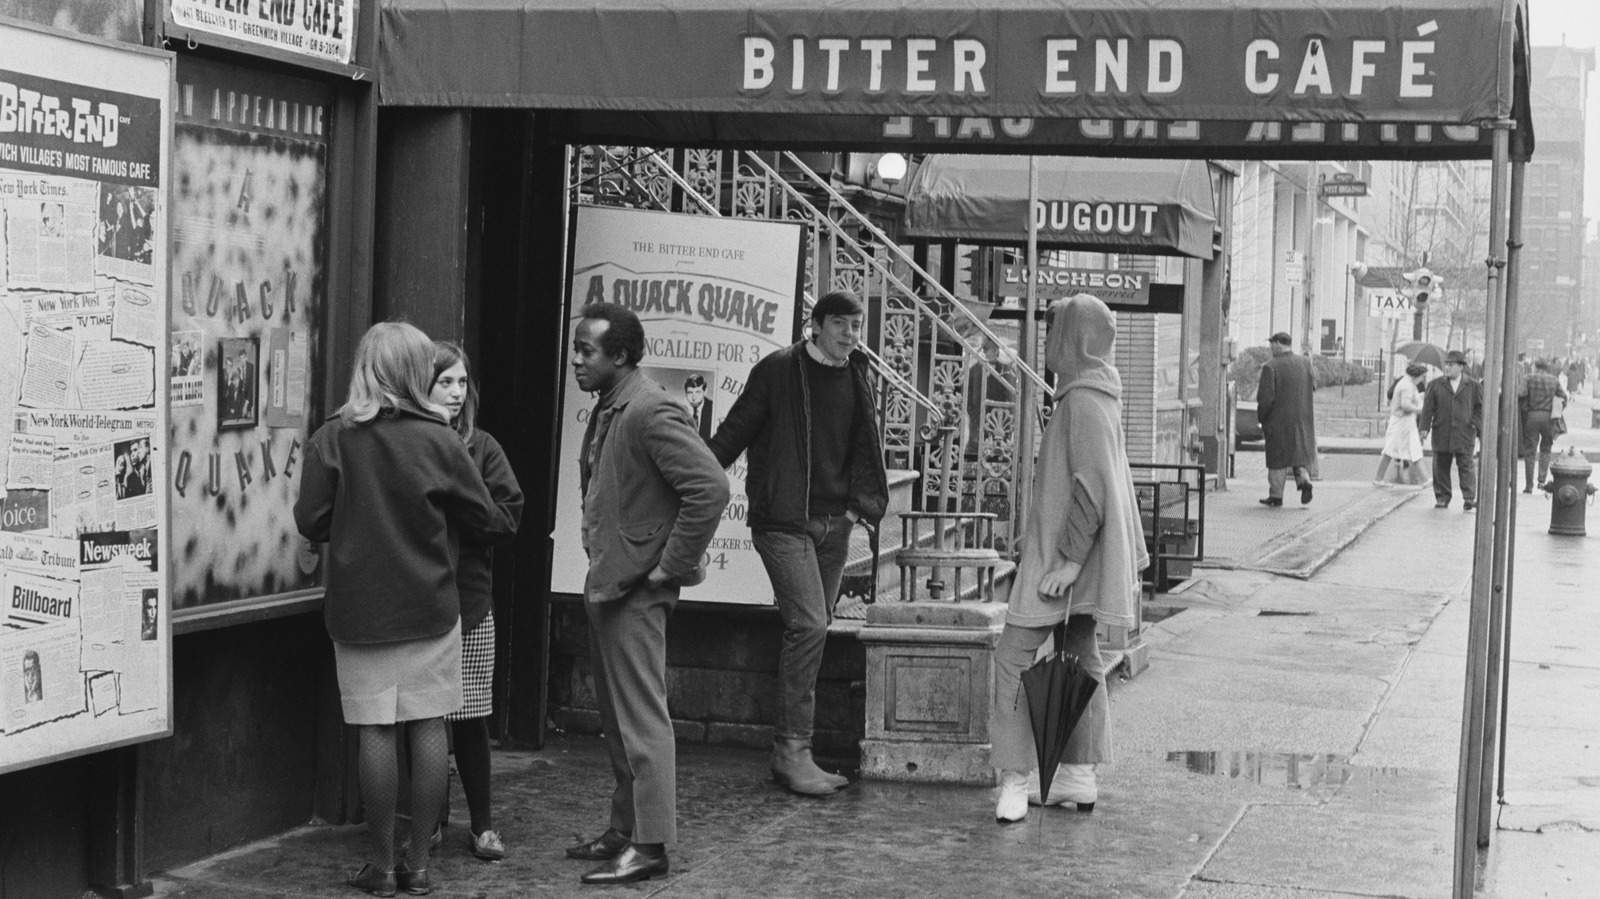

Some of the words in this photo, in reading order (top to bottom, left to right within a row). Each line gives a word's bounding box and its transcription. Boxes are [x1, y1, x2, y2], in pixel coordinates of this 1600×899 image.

[229, 18, 238, 31] ST
[243, 22, 278, 41] GREENWICH
[281, 31, 303, 48] VILLAGE
[303, 0, 344, 39] CAFE
[743, 37, 986, 92] BITTER
[1045, 39, 1183, 94] END
[1245, 19, 1438, 97] CAFÉ
[0, 81, 72, 139] BITTER
[72, 97, 119, 147] END
[211, 88, 323, 136] APPEARING
[20, 145, 63, 168] VILLAGE'S
[65, 152, 90, 172] MOST
[92, 156, 127, 177] FAMOUS
[129, 162, 151, 180] CAFE
[16, 179, 38, 198] York
[633, 241, 654, 253] THE
[659, 243, 696, 256] BITTER
[698, 246, 720, 258] END
[722, 249, 745, 261] CAFE
[38, 299, 56, 312] New
[59, 296, 80, 310] York
[82, 295, 100, 308] Post
[181, 270, 297, 324] QUACK
[585, 275, 605, 305] A
[613, 278, 694, 316] QUACK
[698, 283, 779, 335] QUAKE
[1375, 295, 1411, 309] TAXI
[76, 316, 89, 327] TV
[644, 338, 712, 360] NCALLED
[717, 342, 744, 363] FOR
[30, 413, 49, 428] New
[50, 413, 69, 428] York
[175, 438, 300, 498] QUAKE
[4, 503, 36, 527] oice
[41, 550, 76, 568] Tribune
[83, 538, 151, 562] Newsweek
[12, 585, 72, 618] Billboard
